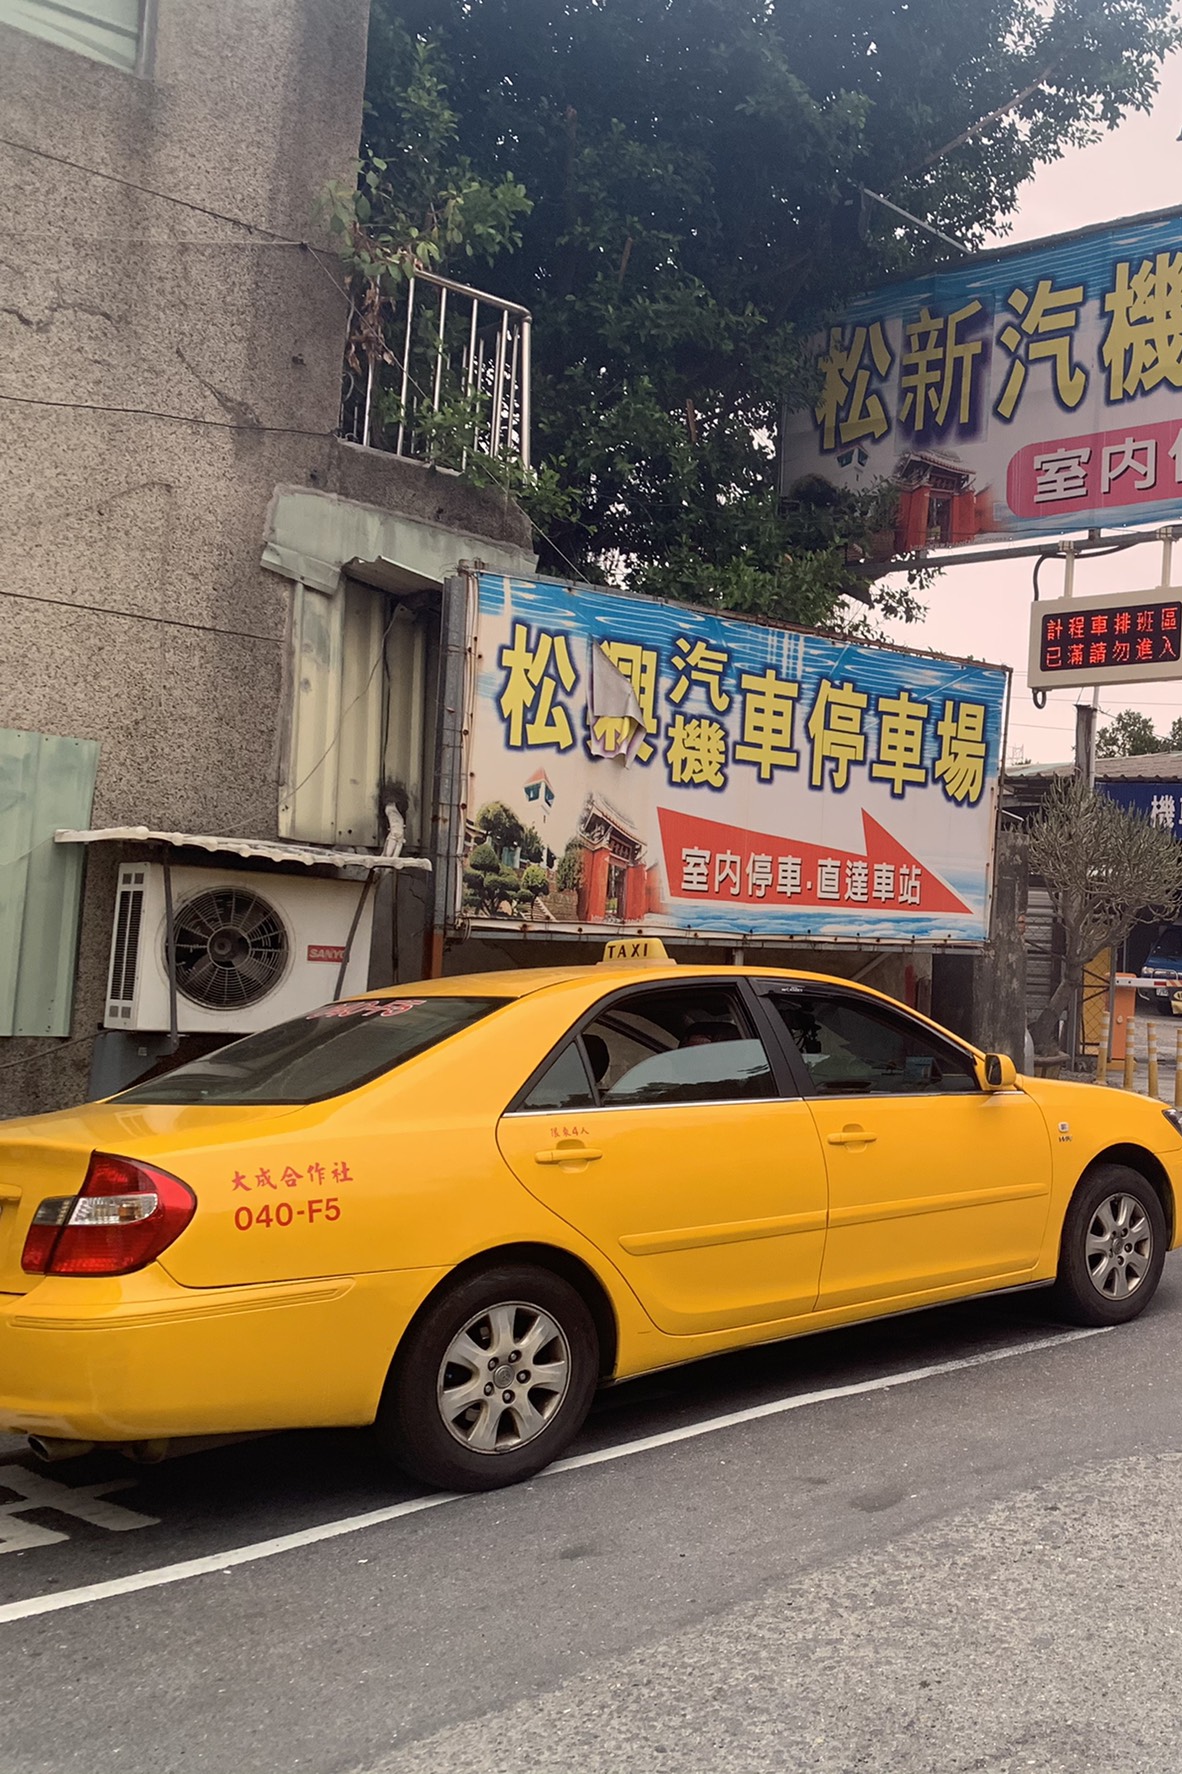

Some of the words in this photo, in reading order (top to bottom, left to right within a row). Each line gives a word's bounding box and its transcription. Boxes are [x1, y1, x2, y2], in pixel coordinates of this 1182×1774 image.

[1046, 606, 1178, 641] 計程車排班區
[1046, 635, 1177, 668] 已滿請勿進入
[607, 943, 648, 959] TAXI
[231, 1161, 354, 1192] 大成合作社
[234, 1197, 342, 1232] 040-F5
